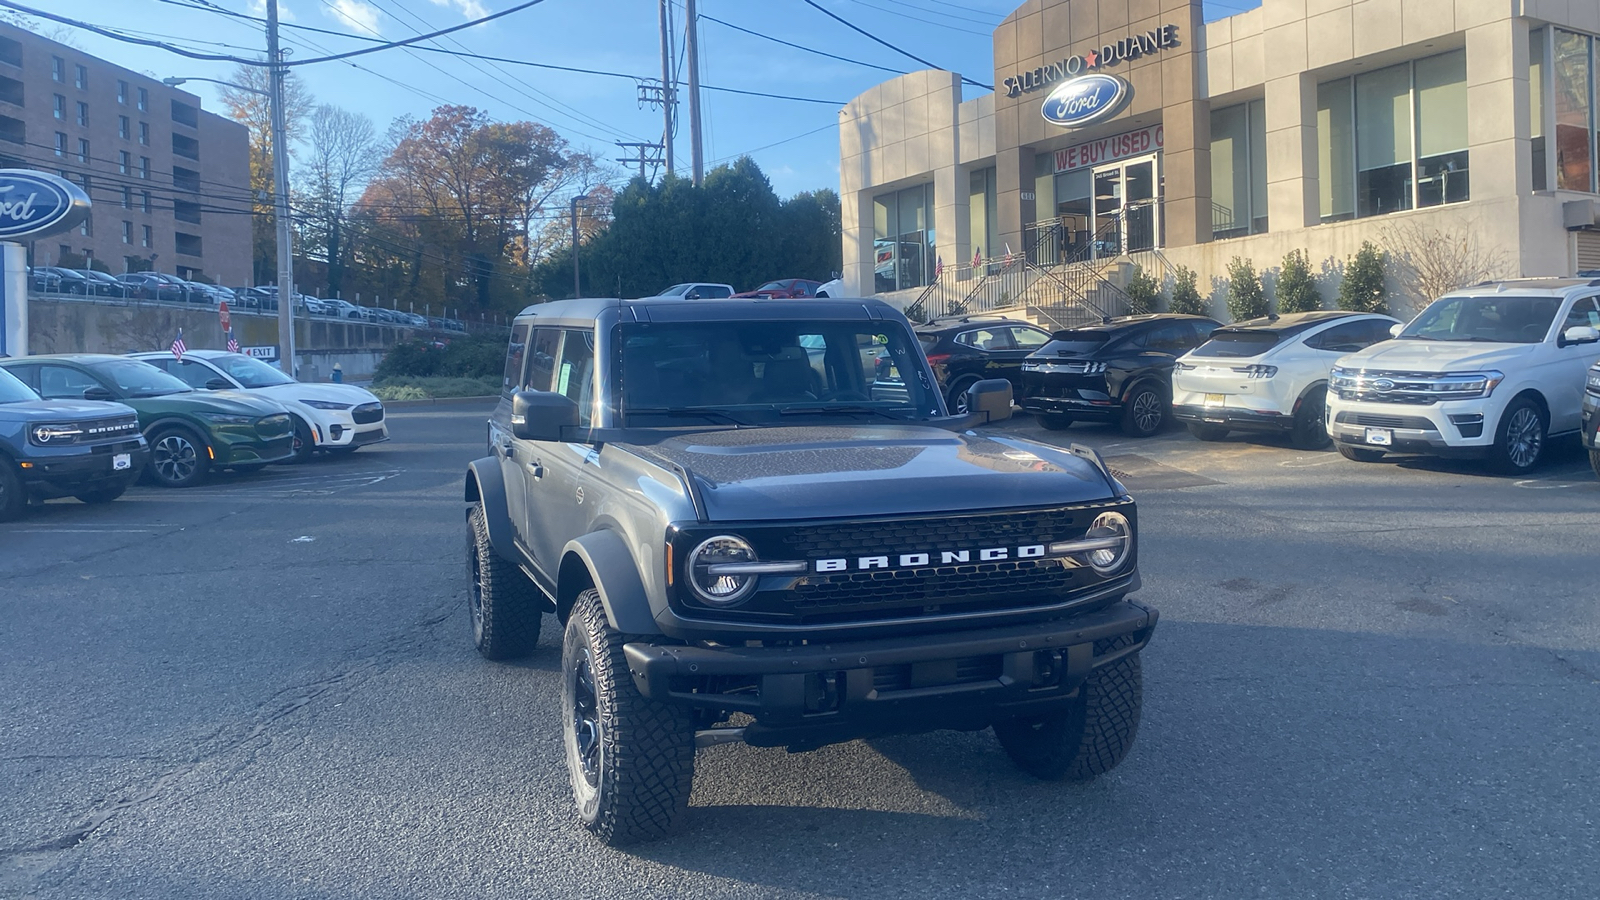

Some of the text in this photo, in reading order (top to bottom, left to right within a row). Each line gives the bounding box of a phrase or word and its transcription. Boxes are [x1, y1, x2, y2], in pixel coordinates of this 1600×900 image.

[1003, 25, 1171, 96] SALERNO DUANE
[1056, 84, 1100, 118] Ford
[1056, 148, 1076, 170] WE
[1081, 140, 1107, 165] BUY
[1112, 130, 1150, 157] USED
[253, 348, 271, 356] EXIT
[89, 423, 135, 433] BRONCO
[815, 545, 1045, 572] BRONCO
